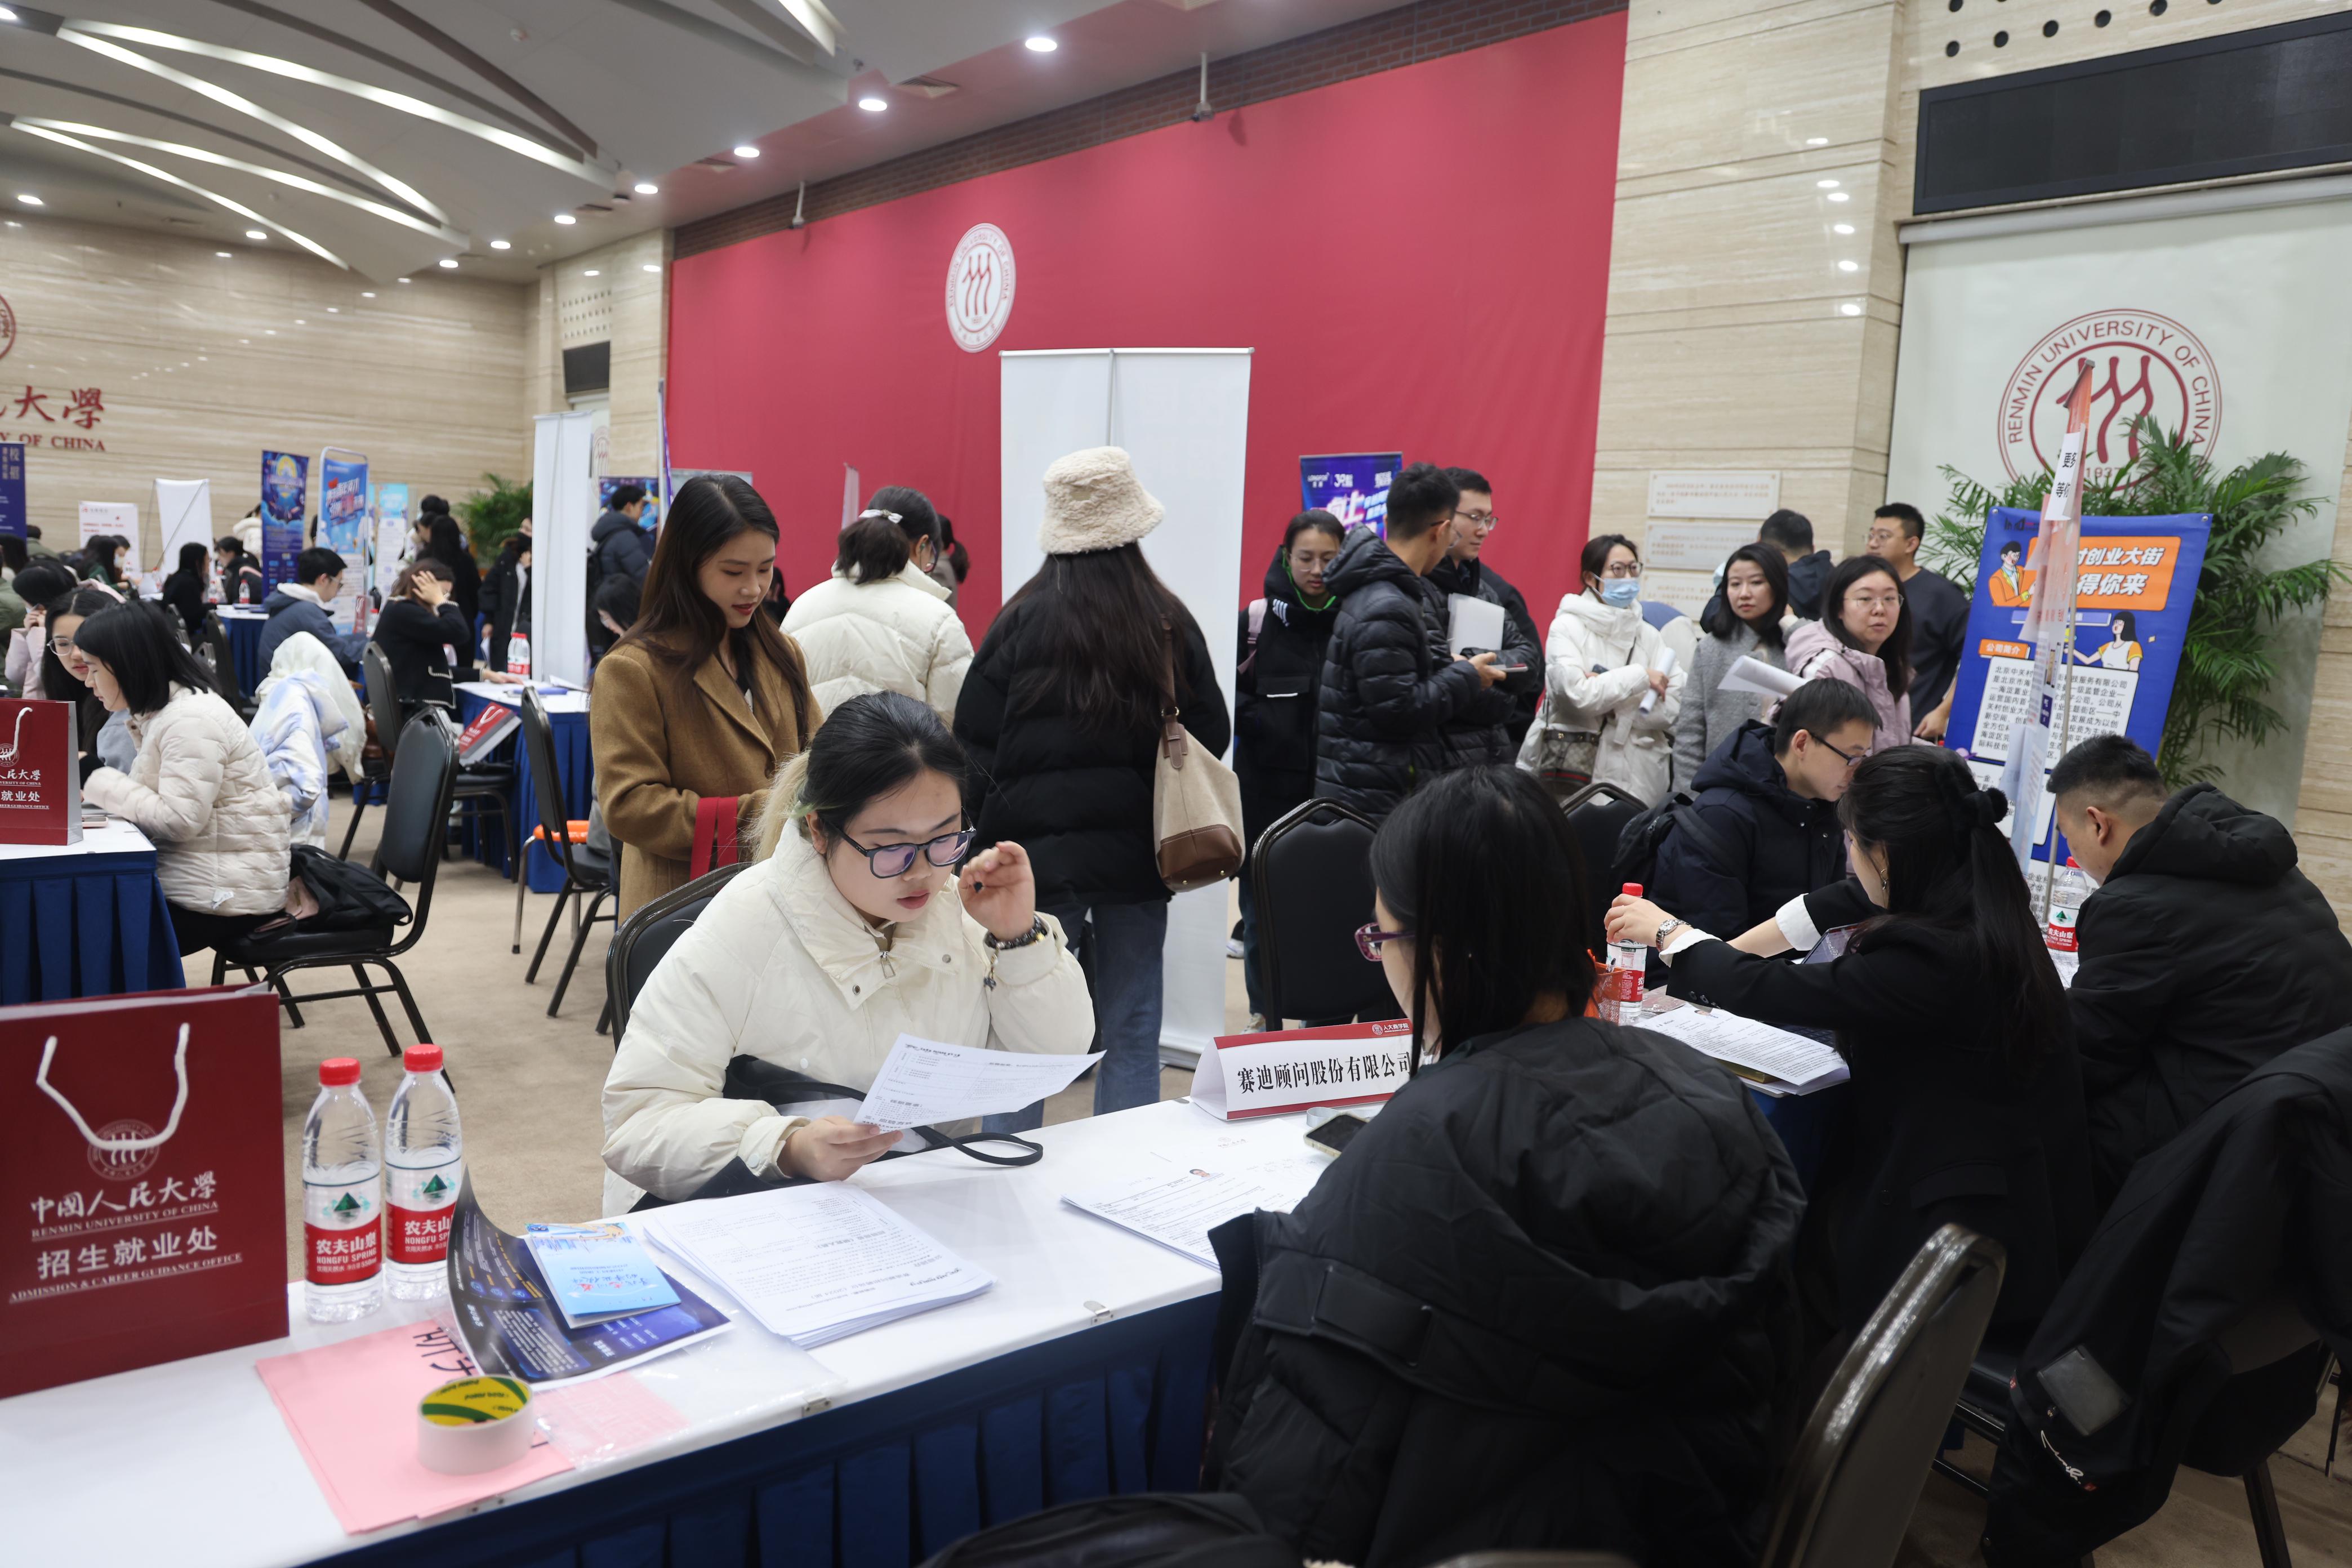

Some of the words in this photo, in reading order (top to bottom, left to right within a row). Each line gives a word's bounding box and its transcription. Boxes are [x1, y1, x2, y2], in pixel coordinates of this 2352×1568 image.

[2008, 364, 2043, 444] RENMIN
[2041, 320, 2174, 363] UNIVERSITY
[2174, 345, 2200, 369] OF
[2191, 376, 2212, 445] CHINA
[0, 385, 104, 429] 大學
[19, 433, 43, 447] OF
[51, 436, 106, 451] CHINA
[1985, 643, 2021, 655] 公司简介
[1, 790, 41, 802] 就业处
[1237, 1051, 1411, 1094] 赛迪顾问股份有限公司
[32, 1222, 82, 1237] RENMIN
[85, 1210, 159, 1230] UNIVERSITY
[162, 1206, 178, 1217] OF
[181, 1201, 219, 1214] CHINA
[405, 1215, 451, 1236] 农夫山
[316, 1231, 376, 1255] 农夫山泉
[405, 1235, 436, 1245] NONGFU
[37, 1225, 217, 1280] 招生就业处
[316, 1256, 349, 1265] NONGFU
[351, 1247, 377, 1262] SPRING
[10, 1282, 78, 1300] ADMISSION
[80, 1280, 90, 1290] &
[92, 1271, 140, 1286] CAREER
[141, 1262, 198, 1278] GUIDANCE
[202, 1253, 242, 1267] OFFICE
